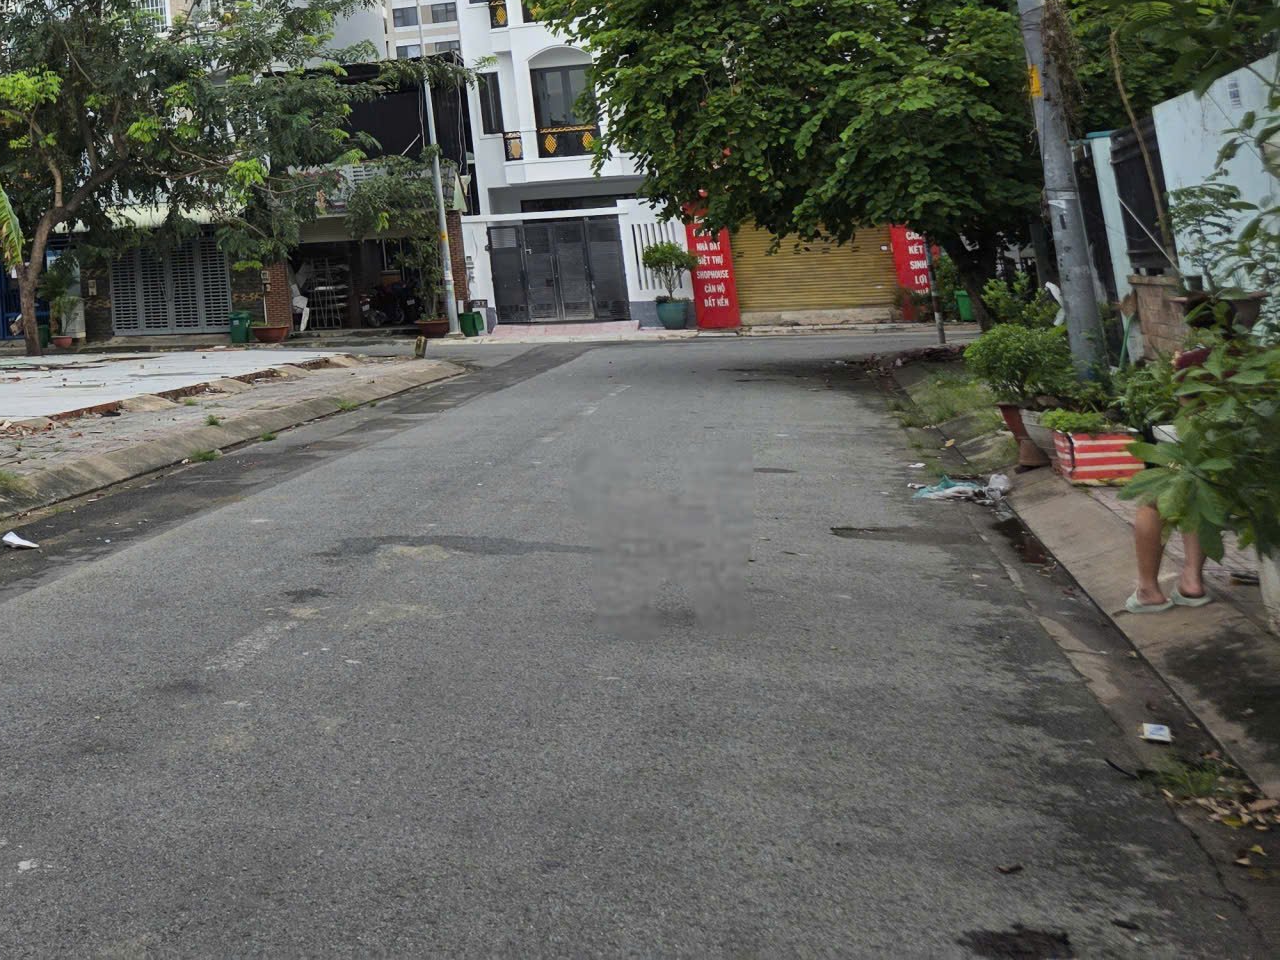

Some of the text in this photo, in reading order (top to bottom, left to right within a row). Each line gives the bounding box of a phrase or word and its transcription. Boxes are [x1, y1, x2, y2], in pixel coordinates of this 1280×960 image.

[908, 242, 923, 254] KẾT
[910, 260, 927, 270] SINH
[696, 269, 729, 279] SHOPHOUSE
